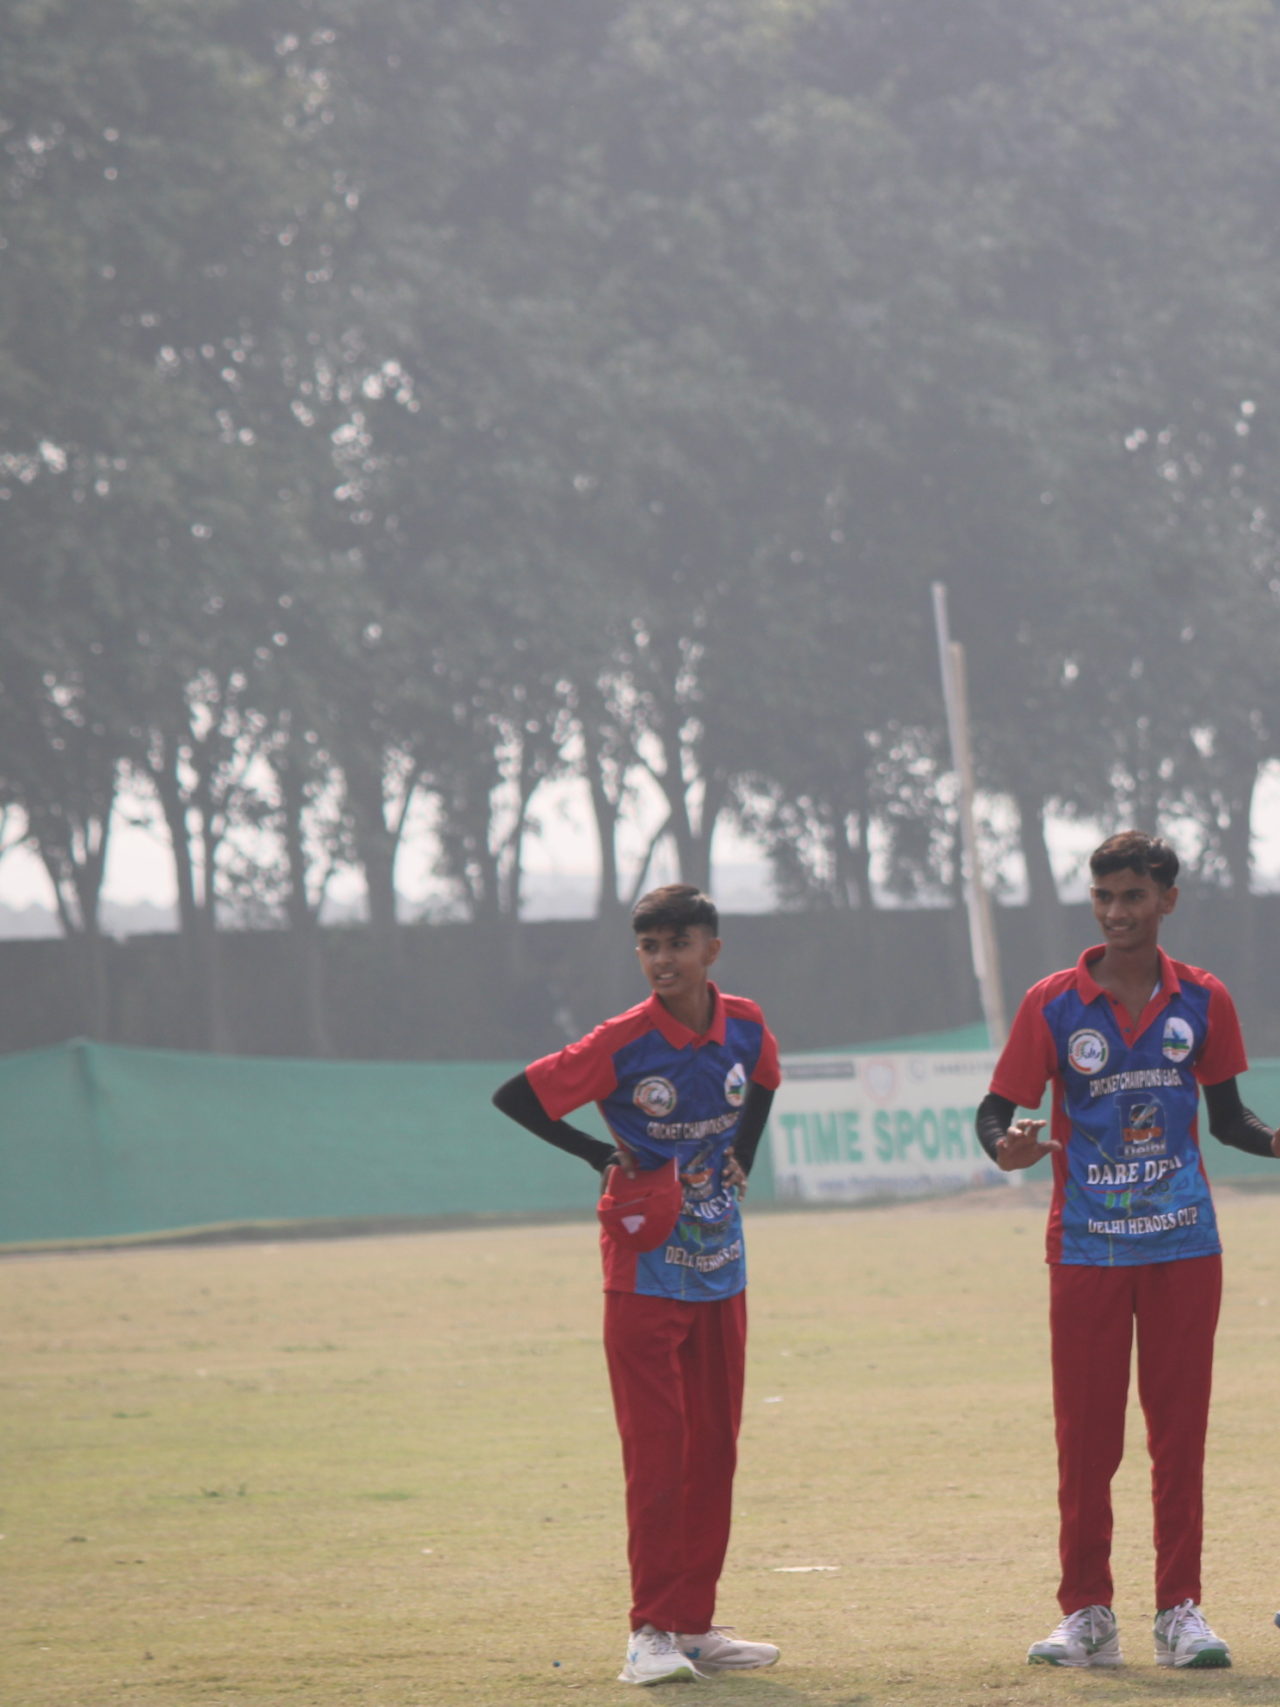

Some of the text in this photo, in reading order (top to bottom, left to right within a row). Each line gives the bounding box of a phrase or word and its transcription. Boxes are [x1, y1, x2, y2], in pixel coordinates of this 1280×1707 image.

[1089, 1073, 1120, 1098] CRICKET
[778, 1111, 863, 1164] TIME
[1086, 1162, 1139, 1186] DARE
[1087, 1206, 1199, 1235] DELHI HEROES CUP
